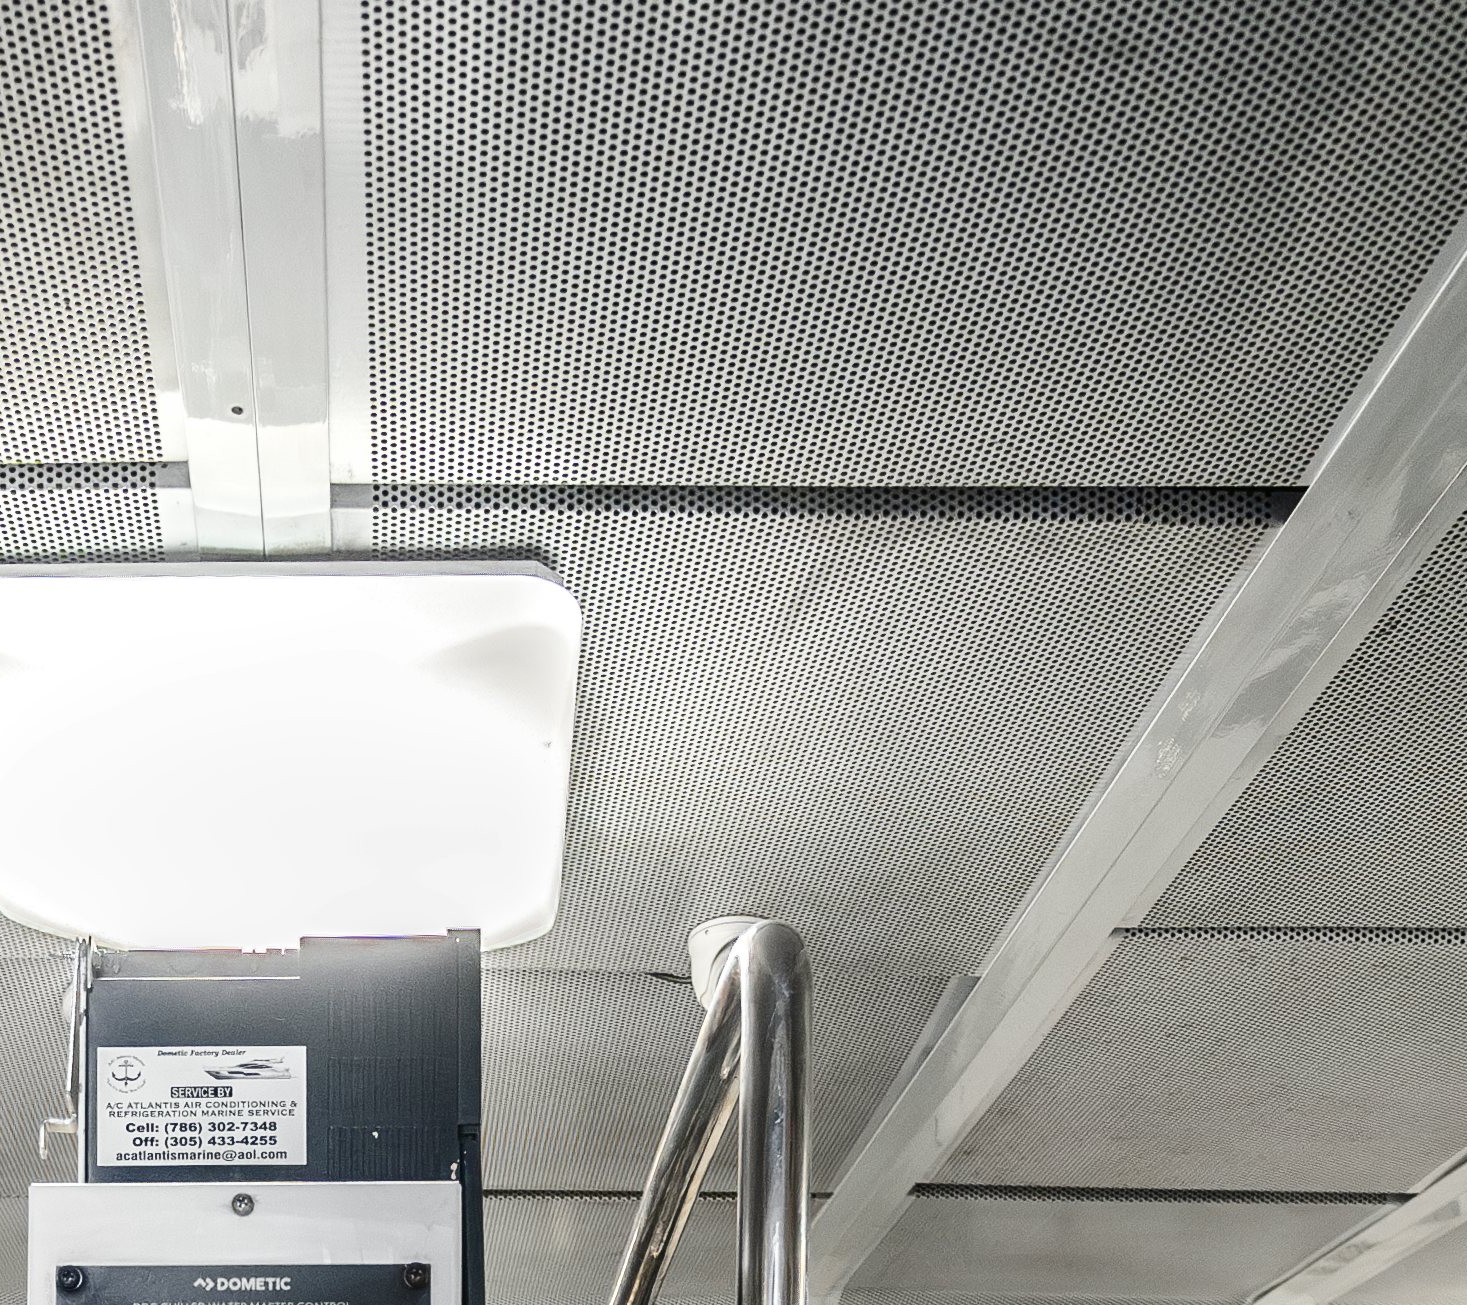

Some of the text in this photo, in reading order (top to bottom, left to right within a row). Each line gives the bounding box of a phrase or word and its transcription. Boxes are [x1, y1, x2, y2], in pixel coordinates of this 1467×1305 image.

[172, 1087, 232, 1098] SERVICE BY
[106, 1100, 298, 1110] A/C ATLANTIS AIR CONDITIONING &
[108, 1110, 197, 1118] REFRIGERATION
[126, 1121, 277, 1134] Cell: (786) 302-7348
[132, 1135, 277, 1148] Off: (305) 433-4255
[116, 1150, 288, 1162] acatlantismarine@aol.com
[217, 1277, 291, 1291] DOMETIC
